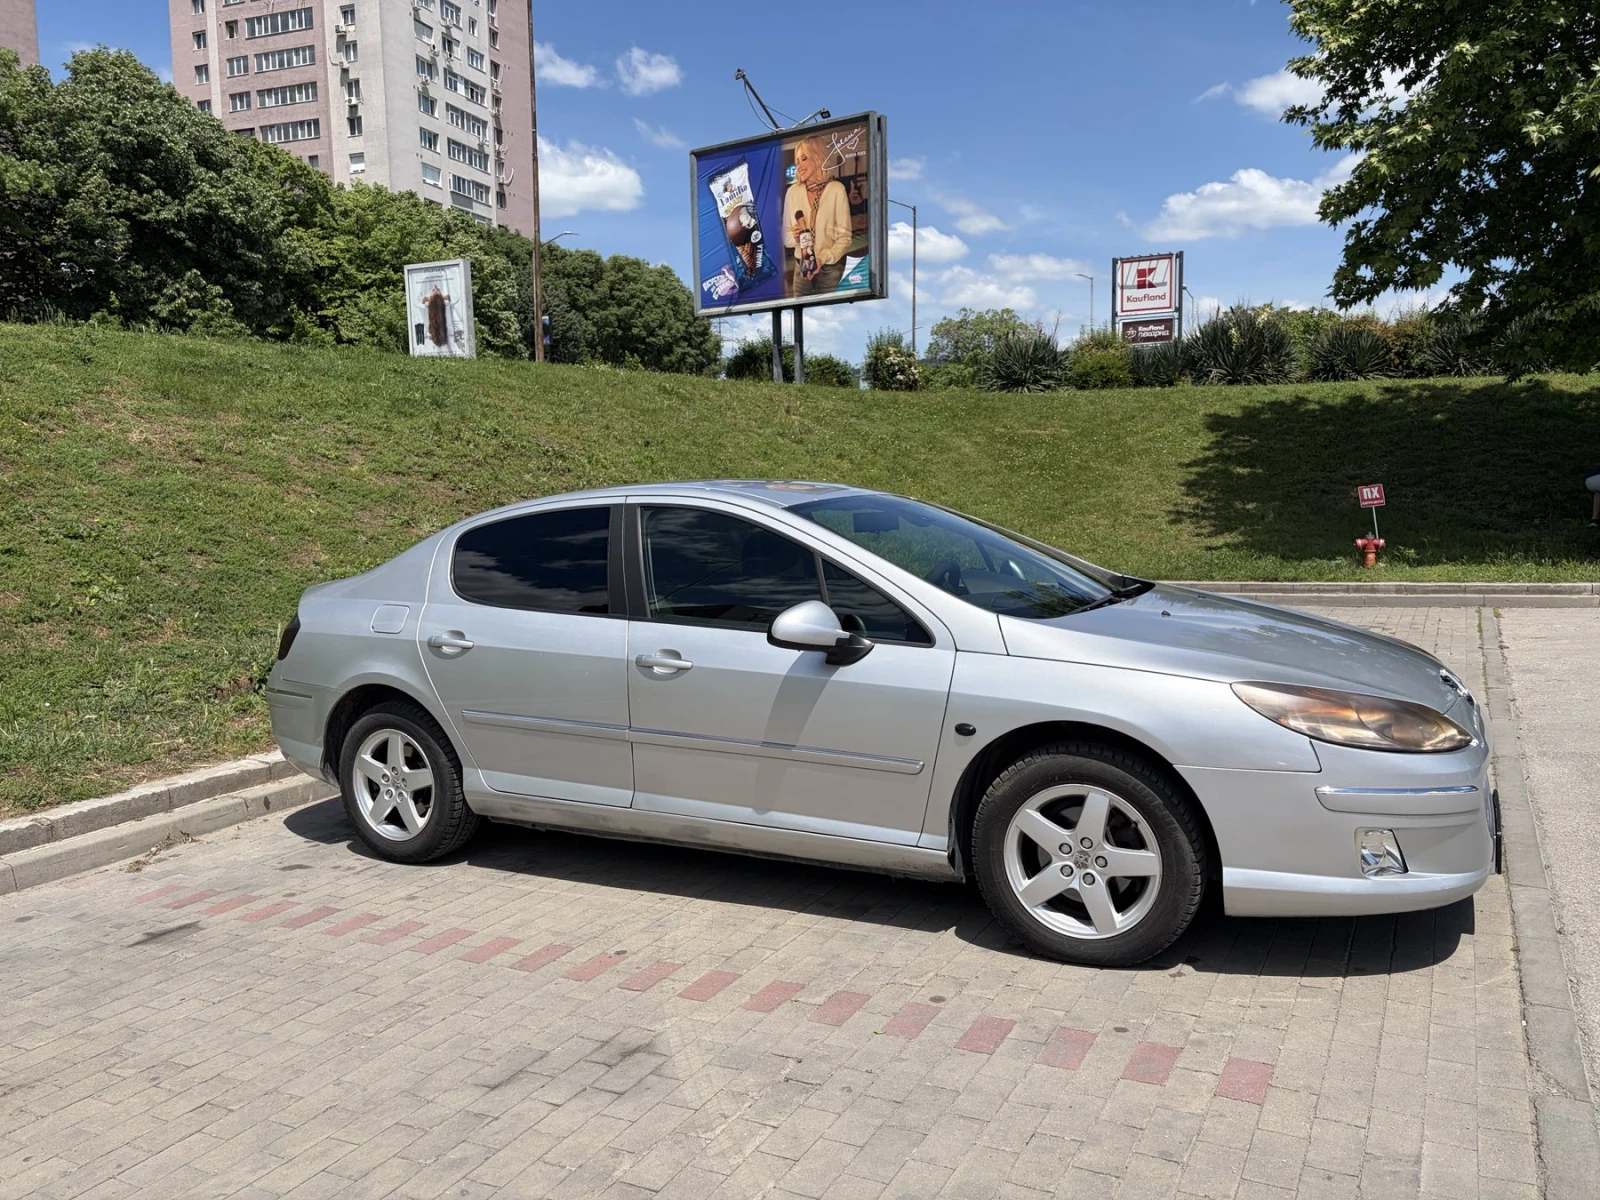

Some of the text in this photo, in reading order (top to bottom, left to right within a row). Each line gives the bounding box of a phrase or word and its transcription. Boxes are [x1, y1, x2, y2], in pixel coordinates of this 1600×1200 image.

[719, 184, 748, 206] Familia
[755, 243, 764, 268] VANILLA
[1126, 292, 1166, 304] Kaufland
[1138, 324, 1165, 332] Kaufland
[1363, 487, 1380, 500] ПХ
